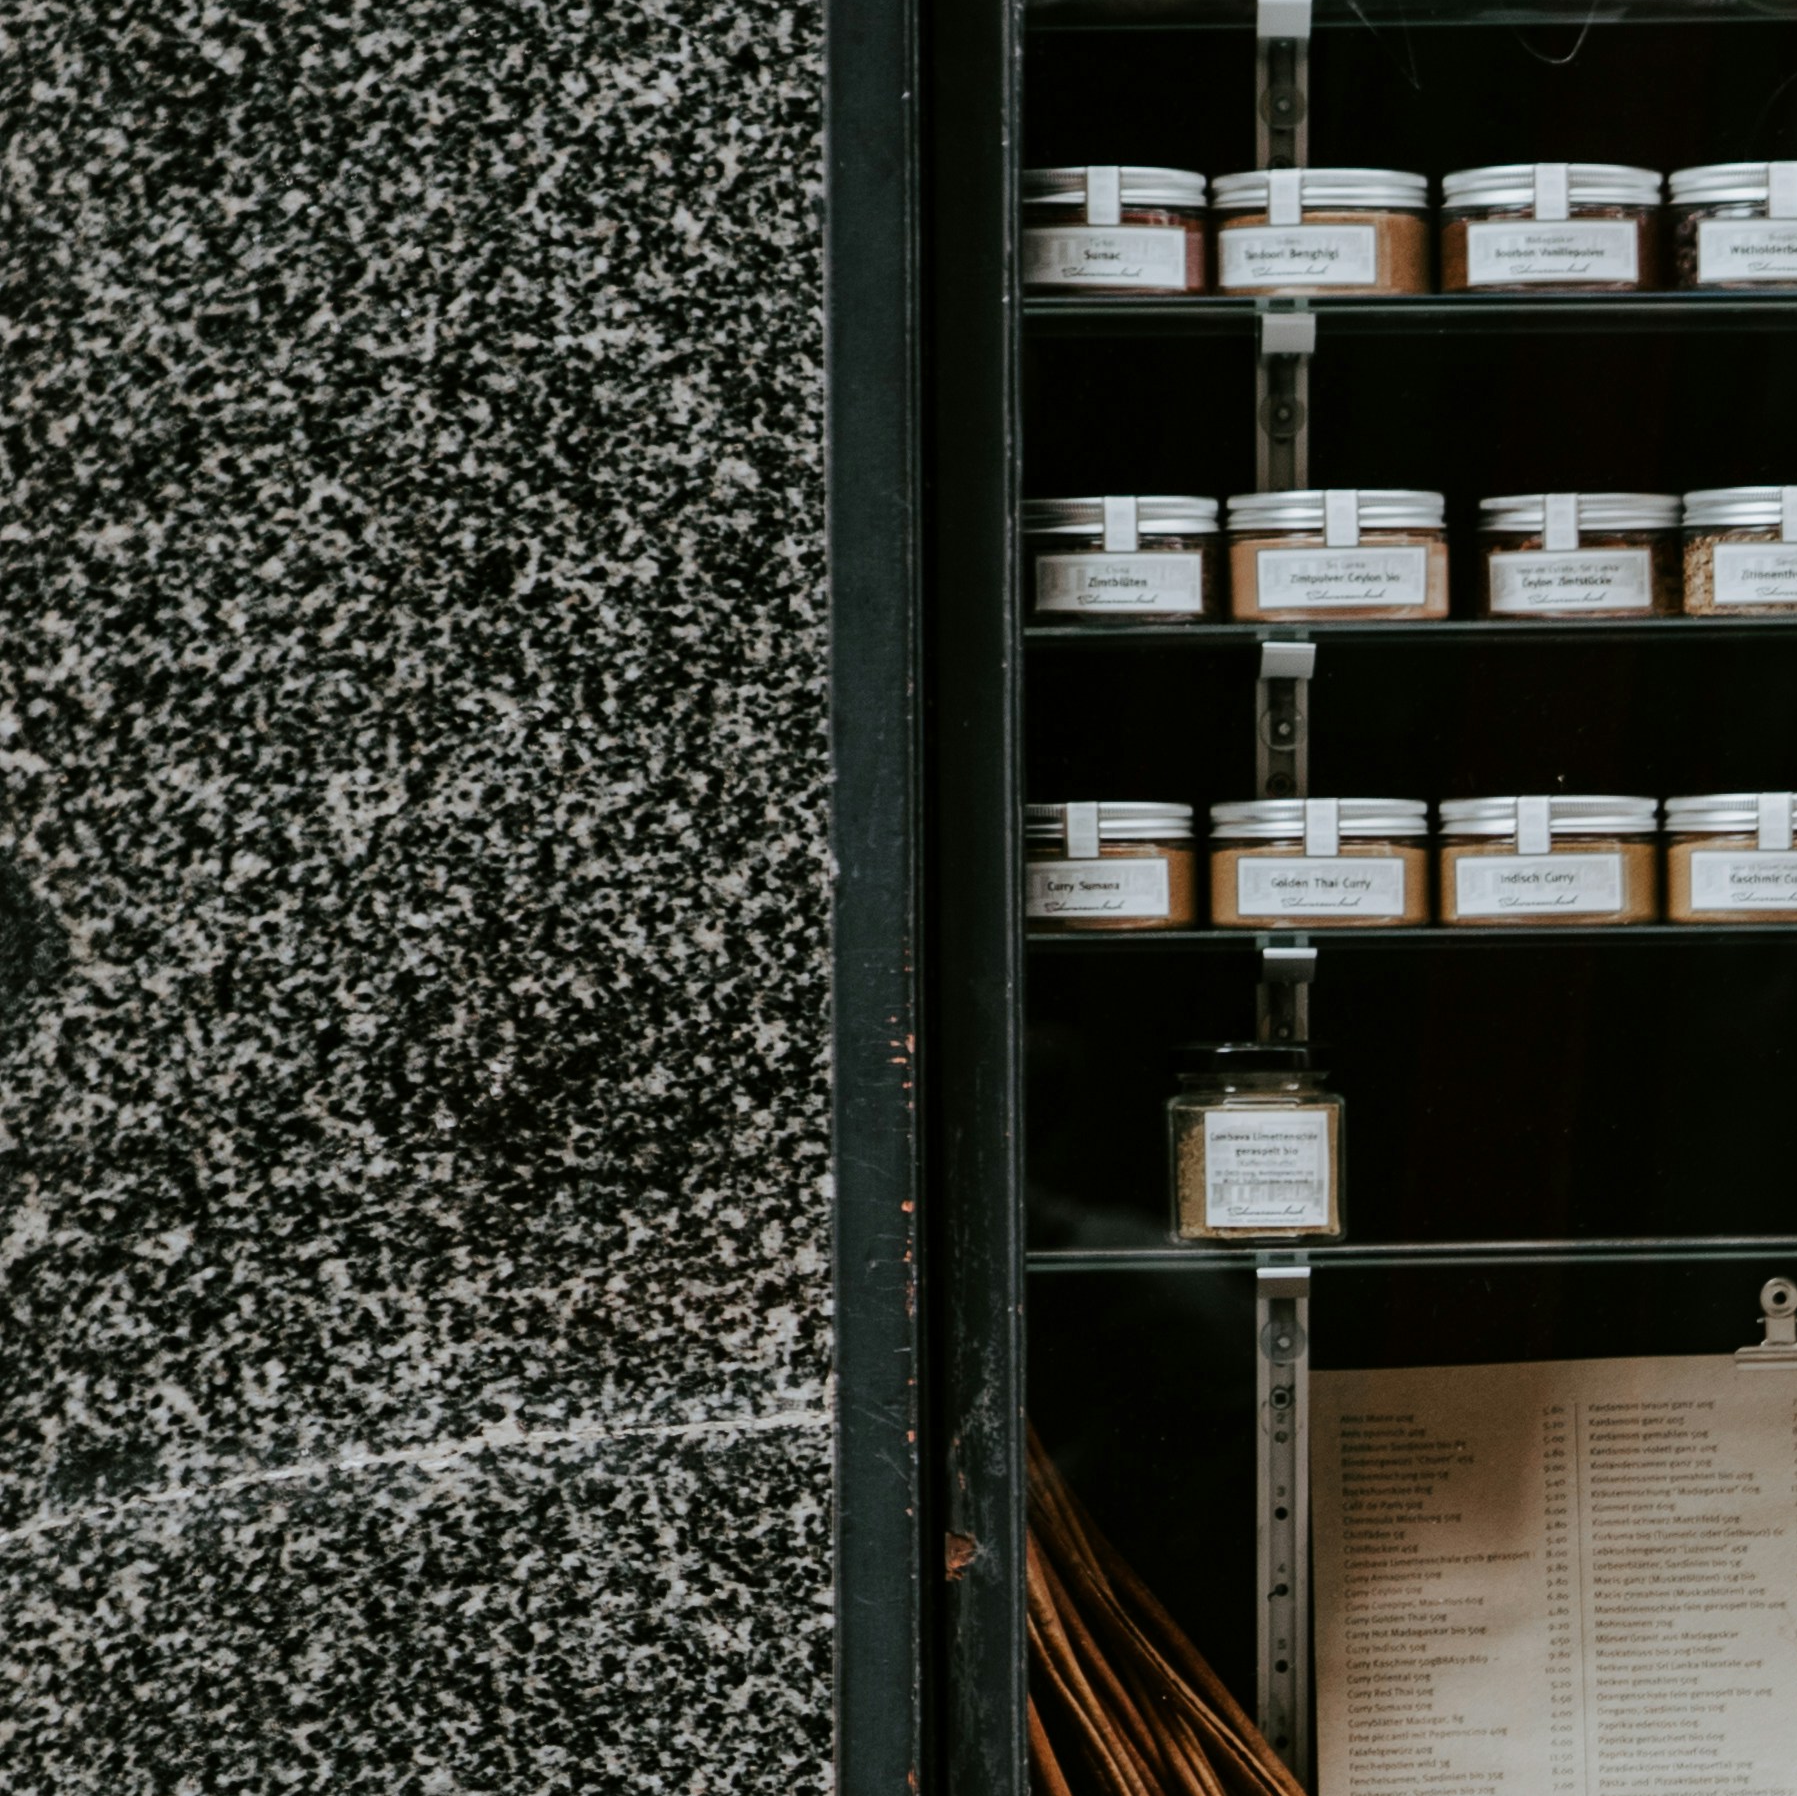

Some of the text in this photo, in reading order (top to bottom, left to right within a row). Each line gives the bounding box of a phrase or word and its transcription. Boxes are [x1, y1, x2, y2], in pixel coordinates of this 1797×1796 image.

[1083, 250, 1121, 260] Sumac
[1244, 249, 1284, 260] Tandoori
[1495, 248, 1535, 258] Bourbon
[1088, 577, 1148, 588] Zimtblüten
[1290, 572, 1401, 585] Zimtpulver Ceylon bio
[1522, 576, 1612, 589] Ceylon Zimtstücke
[1270, 877, 1371, 890] Golden Thai Curry
[1500, 872, 1575, 885] Indisch Curry
[1730, 874, 1782, 885] Kaschmir
[1048, 881, 1074, 893] Curry
[1235, 1147, 1298, 1157] geraspelt bio
[1346, 1631, 1370, 1640] Curry
[1372, 1629, 1389, 1637] Hot
[1391, 1627, 1448, 1638] Madagaskar
[1346, 1645, 1370, 1655] Curry
[1347, 1660, 1371, 1670] Curry
[1348, 1675, 1372, 1685] Curry
[1348, 1690, 1372, 1699] Curry
